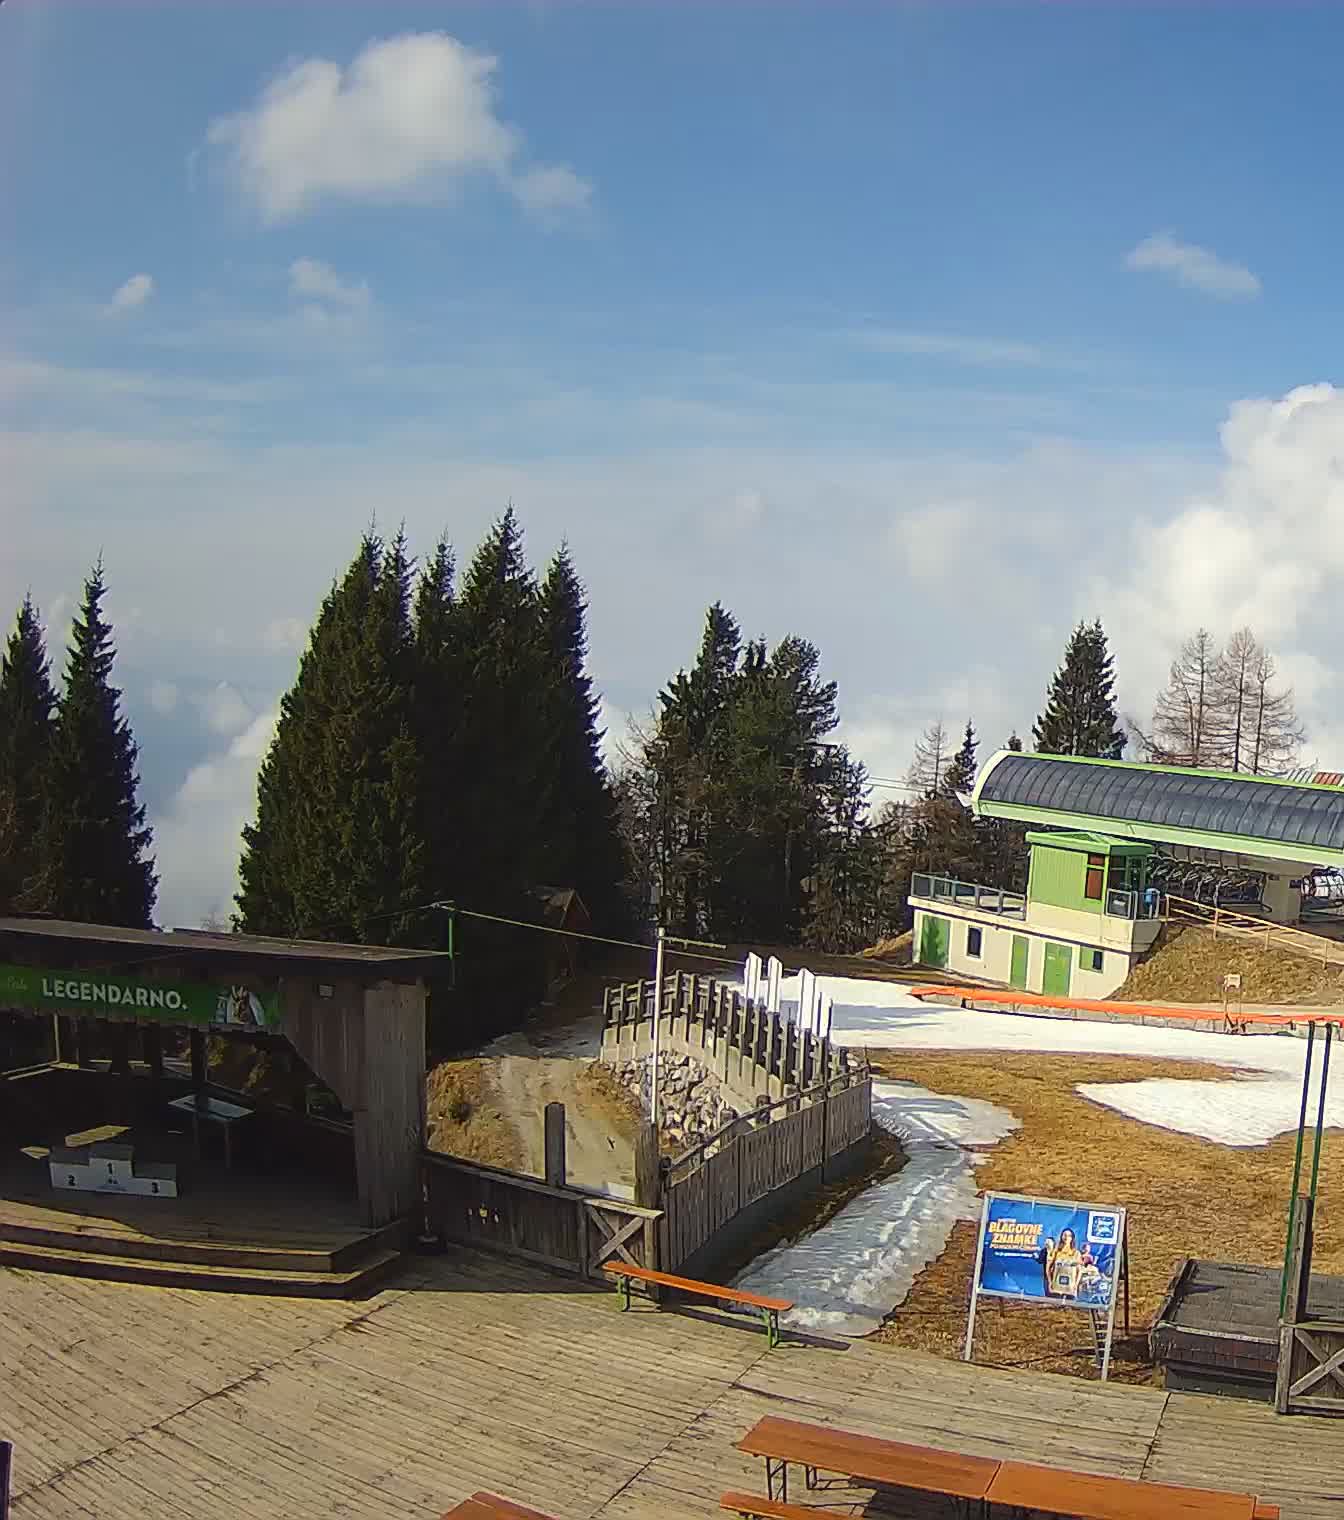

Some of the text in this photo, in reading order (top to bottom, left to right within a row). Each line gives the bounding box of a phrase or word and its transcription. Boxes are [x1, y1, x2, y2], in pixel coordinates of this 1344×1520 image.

[41, 978, 189, 1011] LEGENDARNO.
[107, 1162, 113, 1174] 1
[68, 1174, 76, 1186] 2
[151, 1181, 159, 1193] 3
